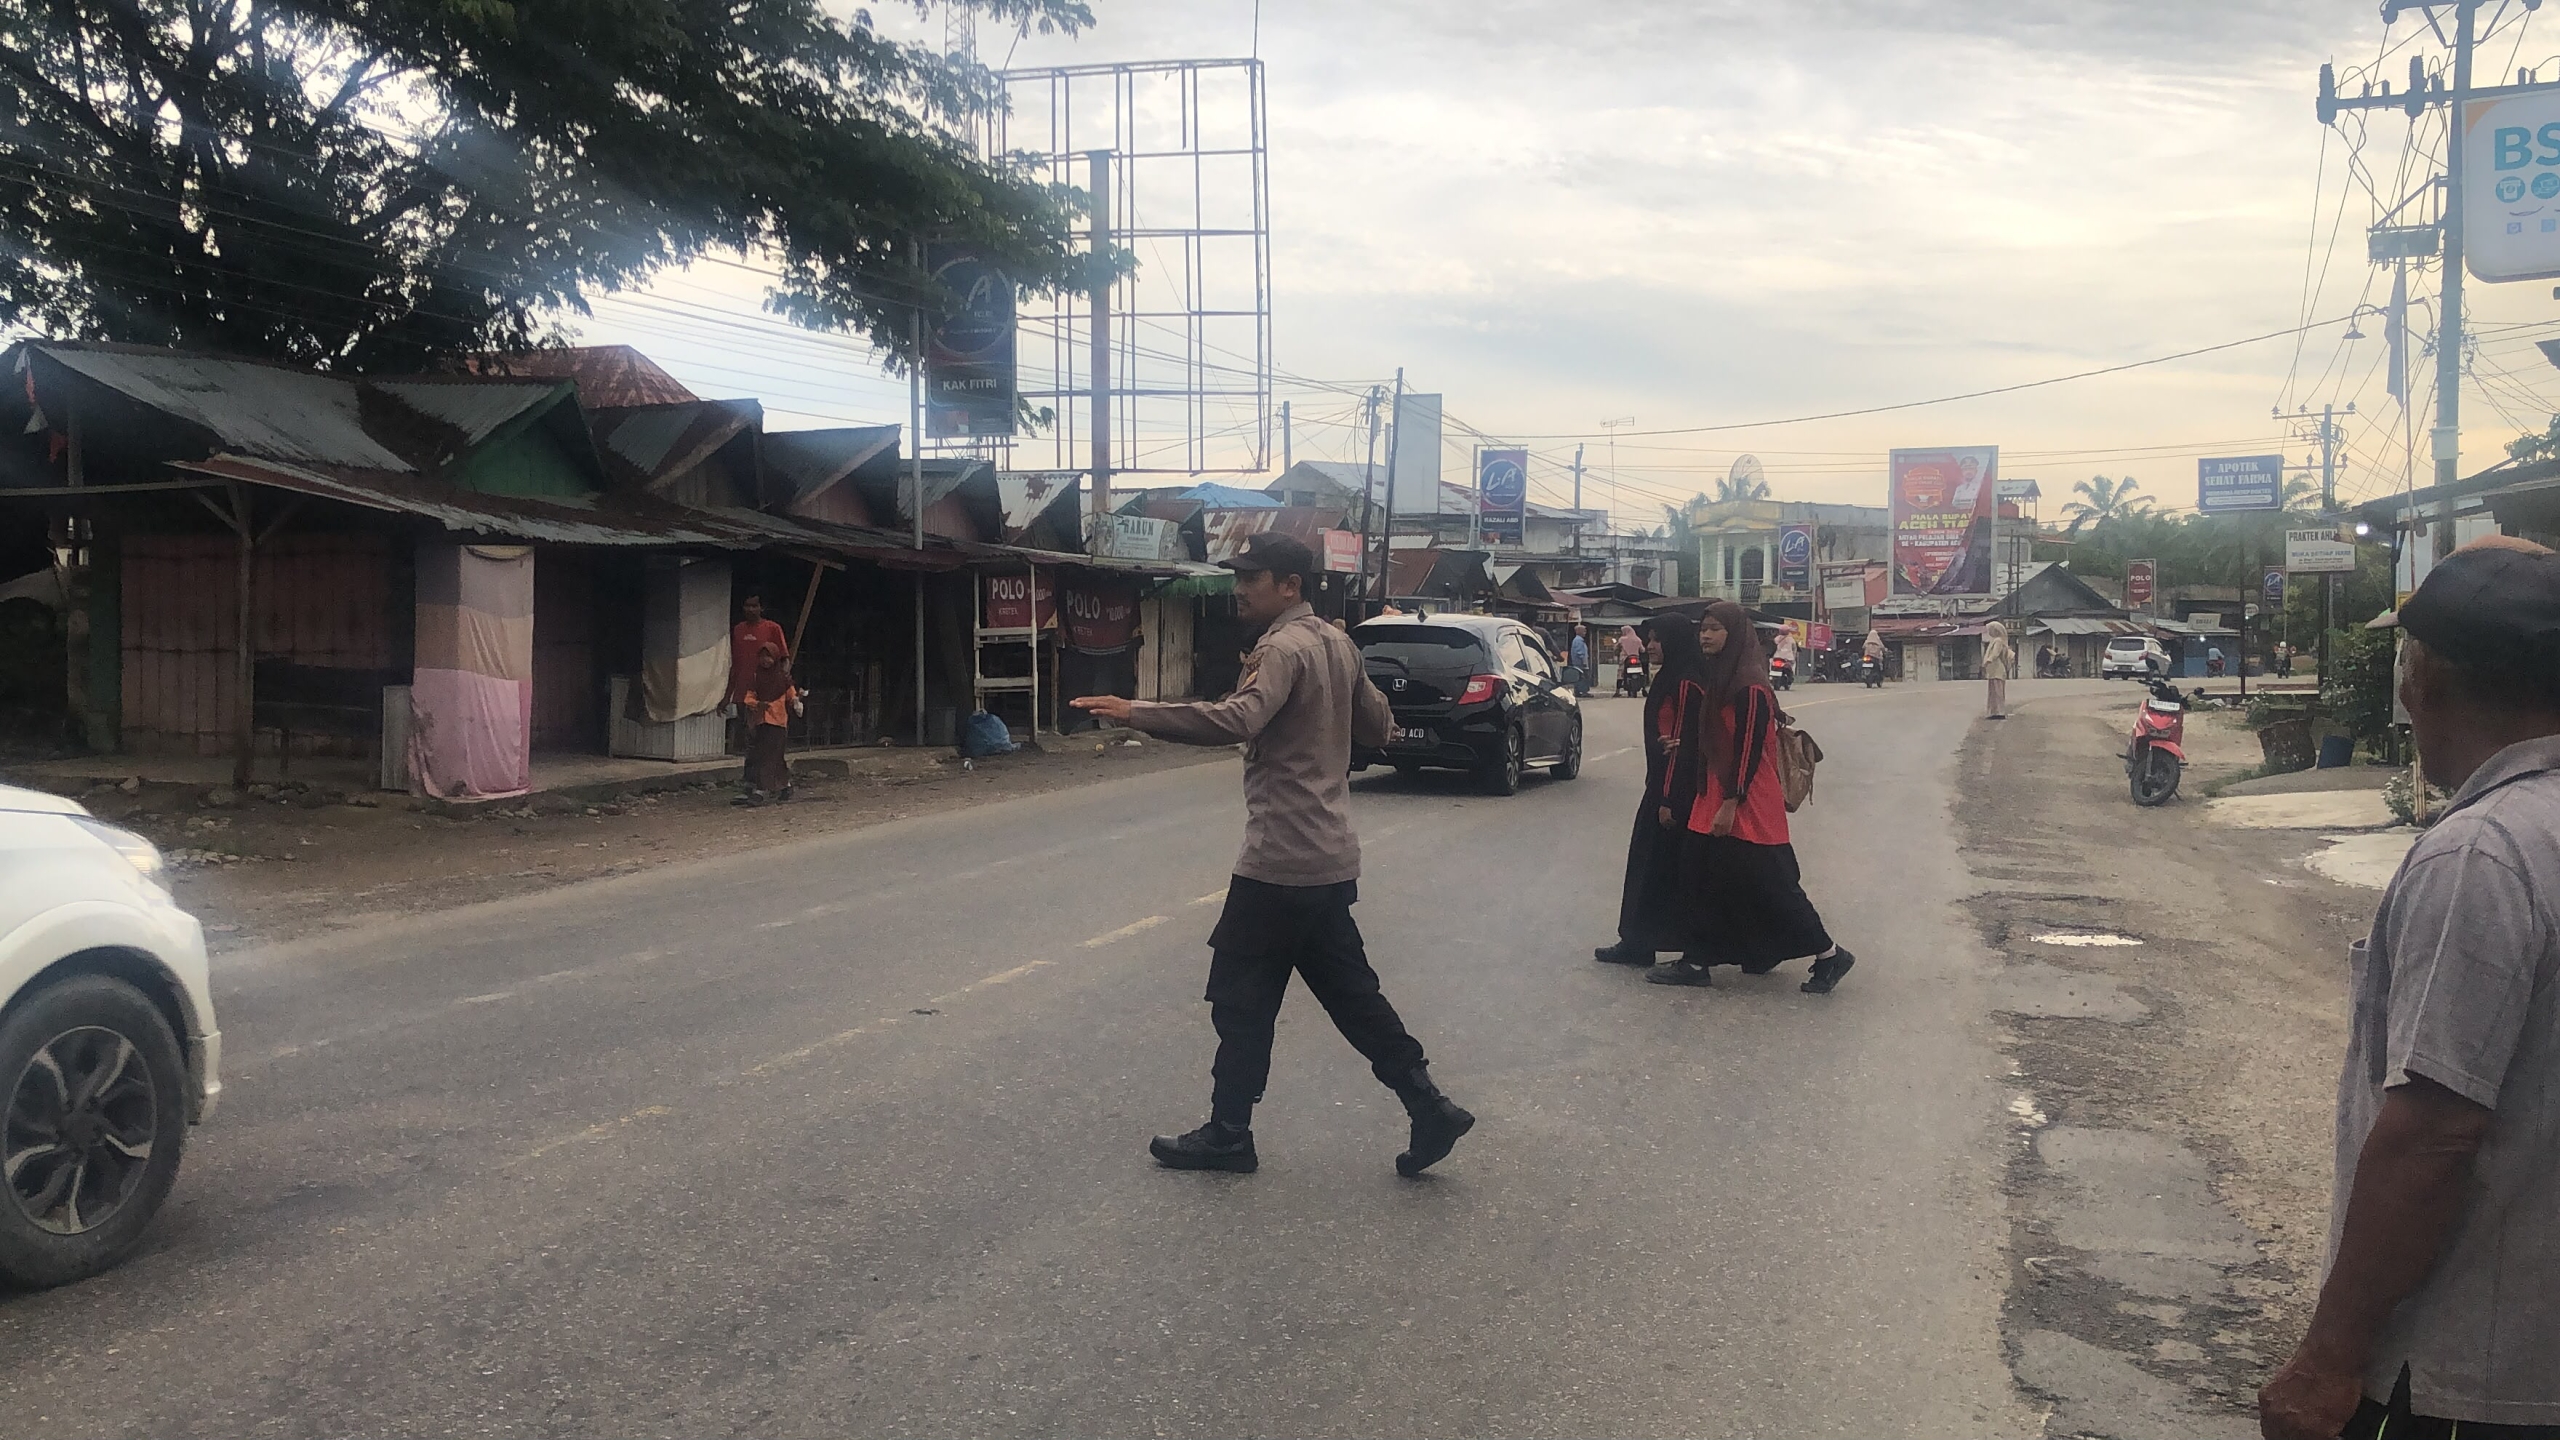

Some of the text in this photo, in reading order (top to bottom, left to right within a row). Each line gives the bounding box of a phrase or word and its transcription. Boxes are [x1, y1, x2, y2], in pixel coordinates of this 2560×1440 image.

[2494, 122, 2560, 172] BS
[943, 378, 997, 391] KAK FITRI
[2218, 462, 2259, 473] APOTEK
[2205, 473, 2273, 486] SEHAT FARMA
[1910, 513, 1939, 521] PIALA
[1898, 520, 1938, 530] ACEH
[2288, 531, 2319, 542] PRAKTEK
[992, 578, 1025, 600] POLO
[1066, 589, 1100, 620] POLO
[1408, 727, 1424, 738] ACD
